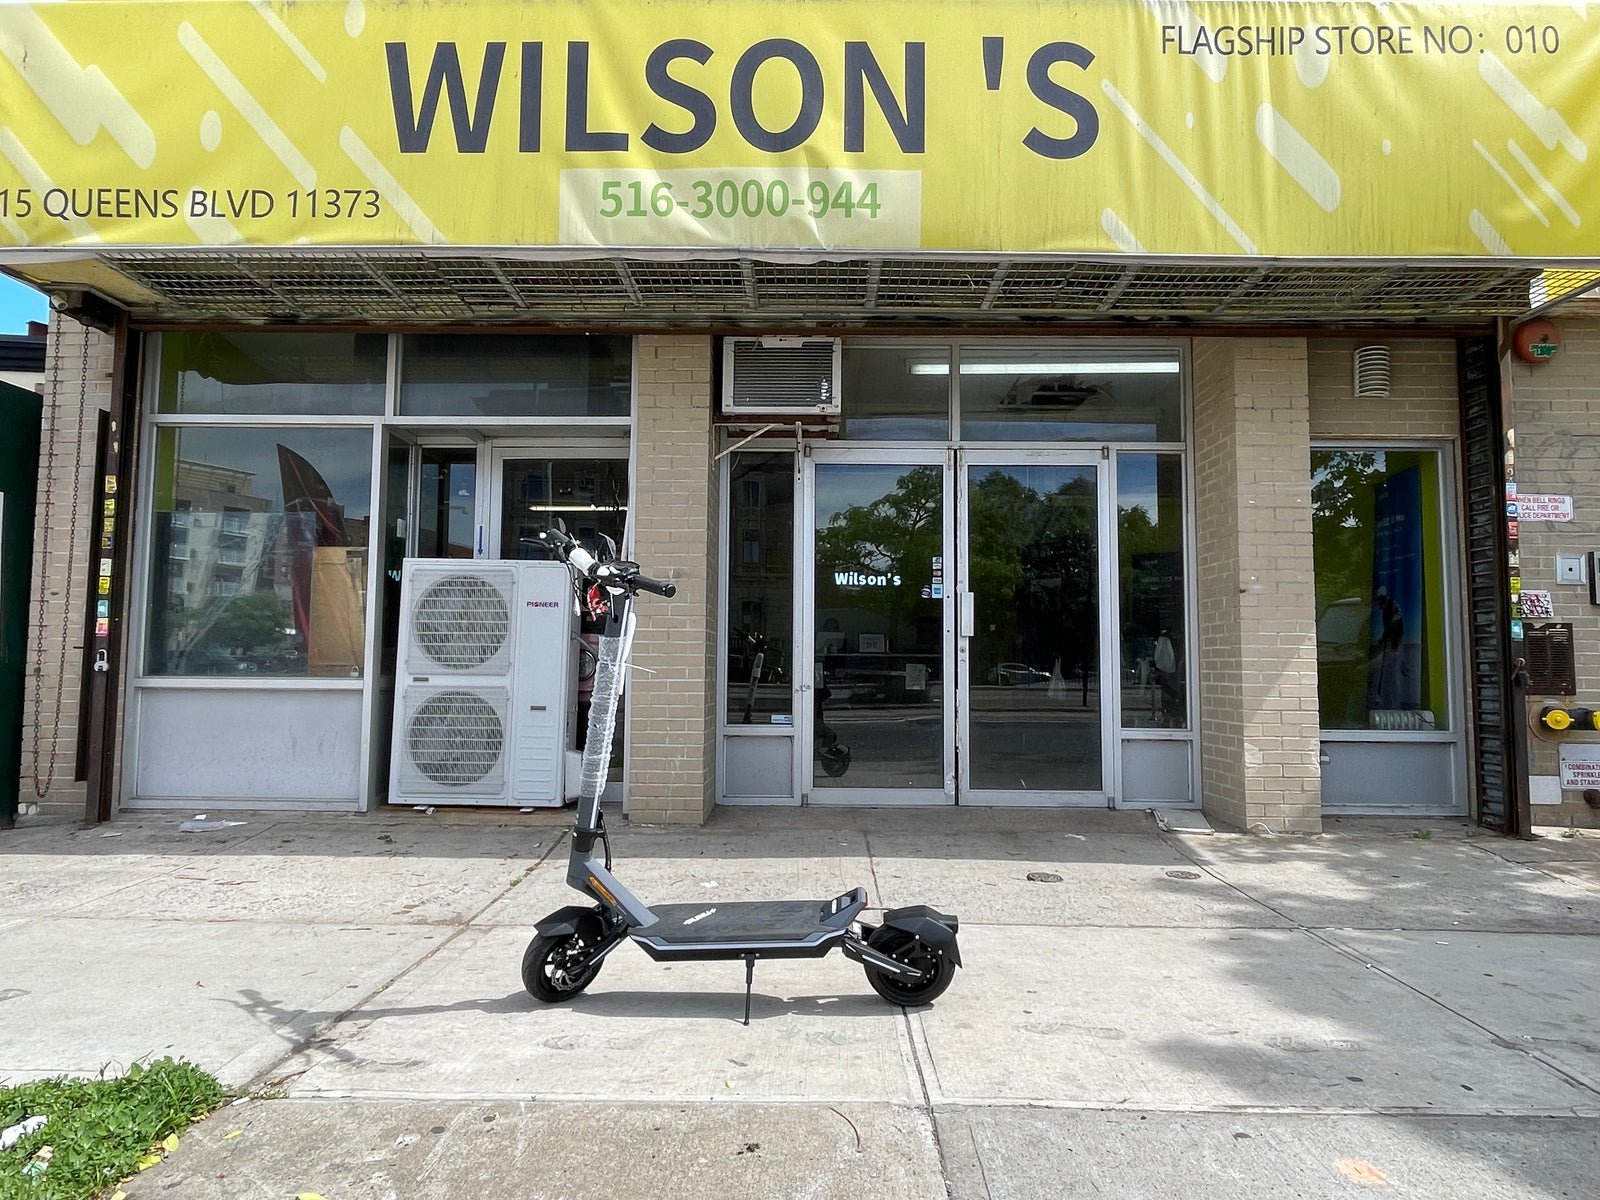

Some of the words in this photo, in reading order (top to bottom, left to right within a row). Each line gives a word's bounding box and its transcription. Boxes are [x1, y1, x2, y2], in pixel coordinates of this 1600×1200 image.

[1162, 25, 1305, 56] FLAGSHIP
[1315, 25, 1415, 55] STORE
[1506, 25, 1560, 54] 010
[384, 38, 926, 154] WILSON
[0, 188, 32, 218] 15
[43, 188, 178, 221] QUEENS
[190, 189, 275, 218] BLVD
[286, 189, 381, 218] 11373
[599, 179, 882, 219] 516-3000-944
[1532, 511, 1570, 519] DEPARTMENT
